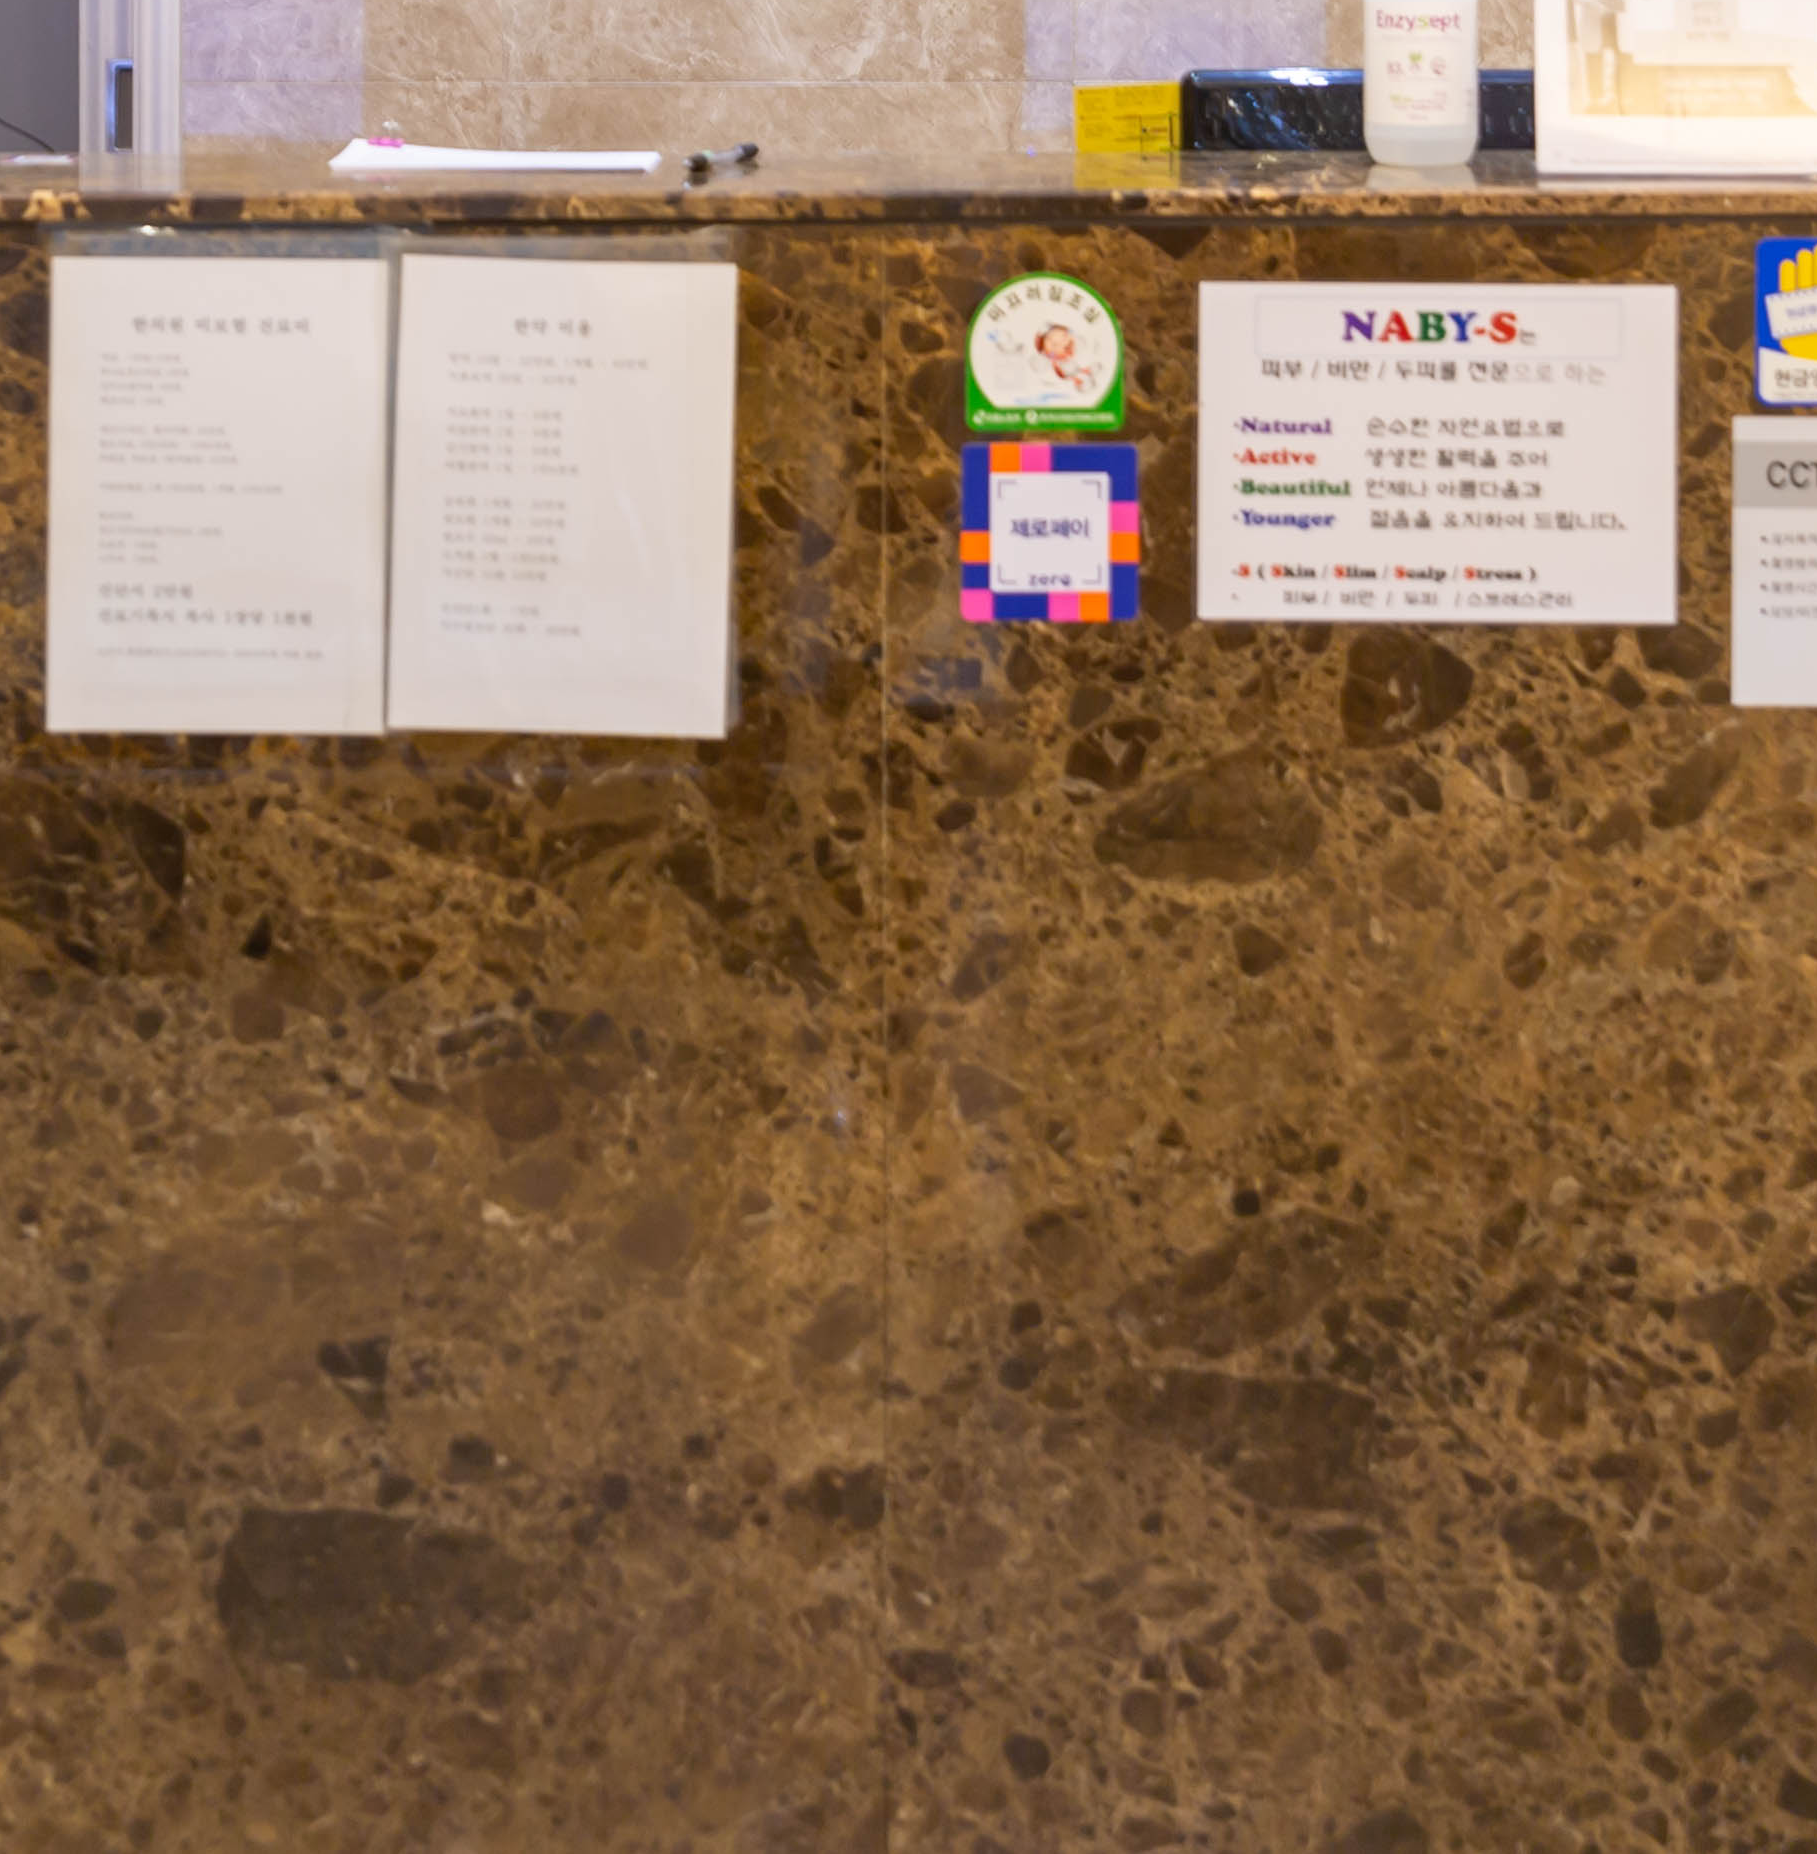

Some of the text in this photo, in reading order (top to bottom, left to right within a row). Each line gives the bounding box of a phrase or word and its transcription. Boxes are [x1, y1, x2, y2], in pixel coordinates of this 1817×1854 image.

[1376, 10, 1462, 32] Enzysept
[1261, 359, 1303, 380] 피부
[1327, 359, 1370, 381] 비만
[1395, 360, 1457, 382] 두피를
[1239, 417, 1333, 436] Natural
[1366, 417, 1431, 439] 순수한
[1239, 448, 1317, 466] Active
[1239, 479, 1352, 498] Beautiful
[1366, 479, 1429, 500] 언제나
[1010, 517, 1090, 539] 제로페이
[1241, 509, 1336, 530] Younger
[1271, 563, 1316, 579] Skin
[1334, 564, 1377, 579] Slim
